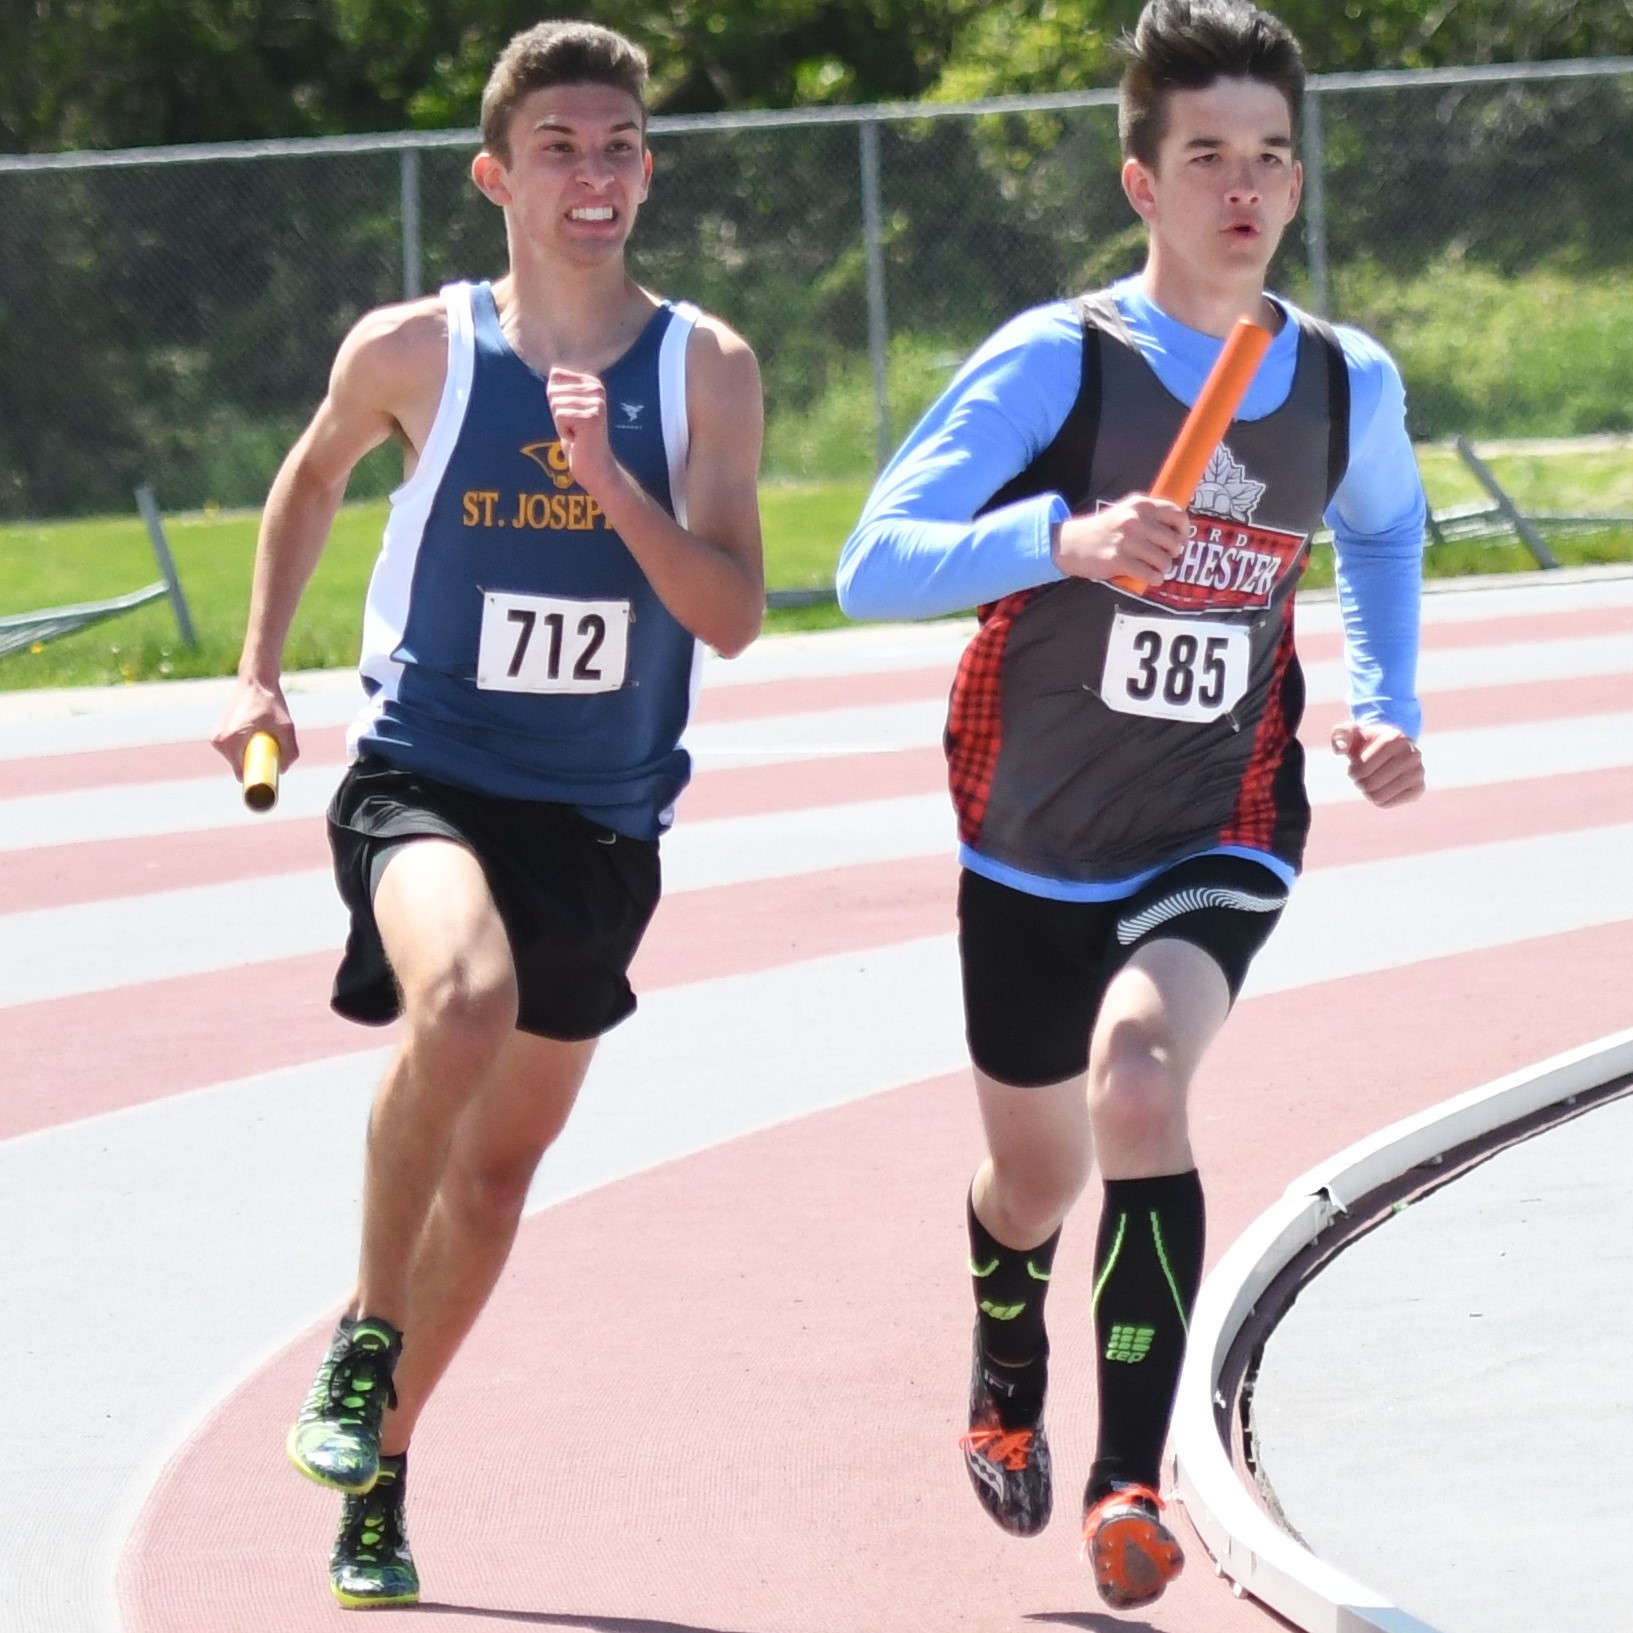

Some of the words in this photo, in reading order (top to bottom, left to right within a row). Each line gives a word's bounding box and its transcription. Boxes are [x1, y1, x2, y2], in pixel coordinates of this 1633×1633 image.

[463, 492, 505, 527] ST.
[507, 609, 606, 681] 712
[1126, 630, 1229, 709] 385
